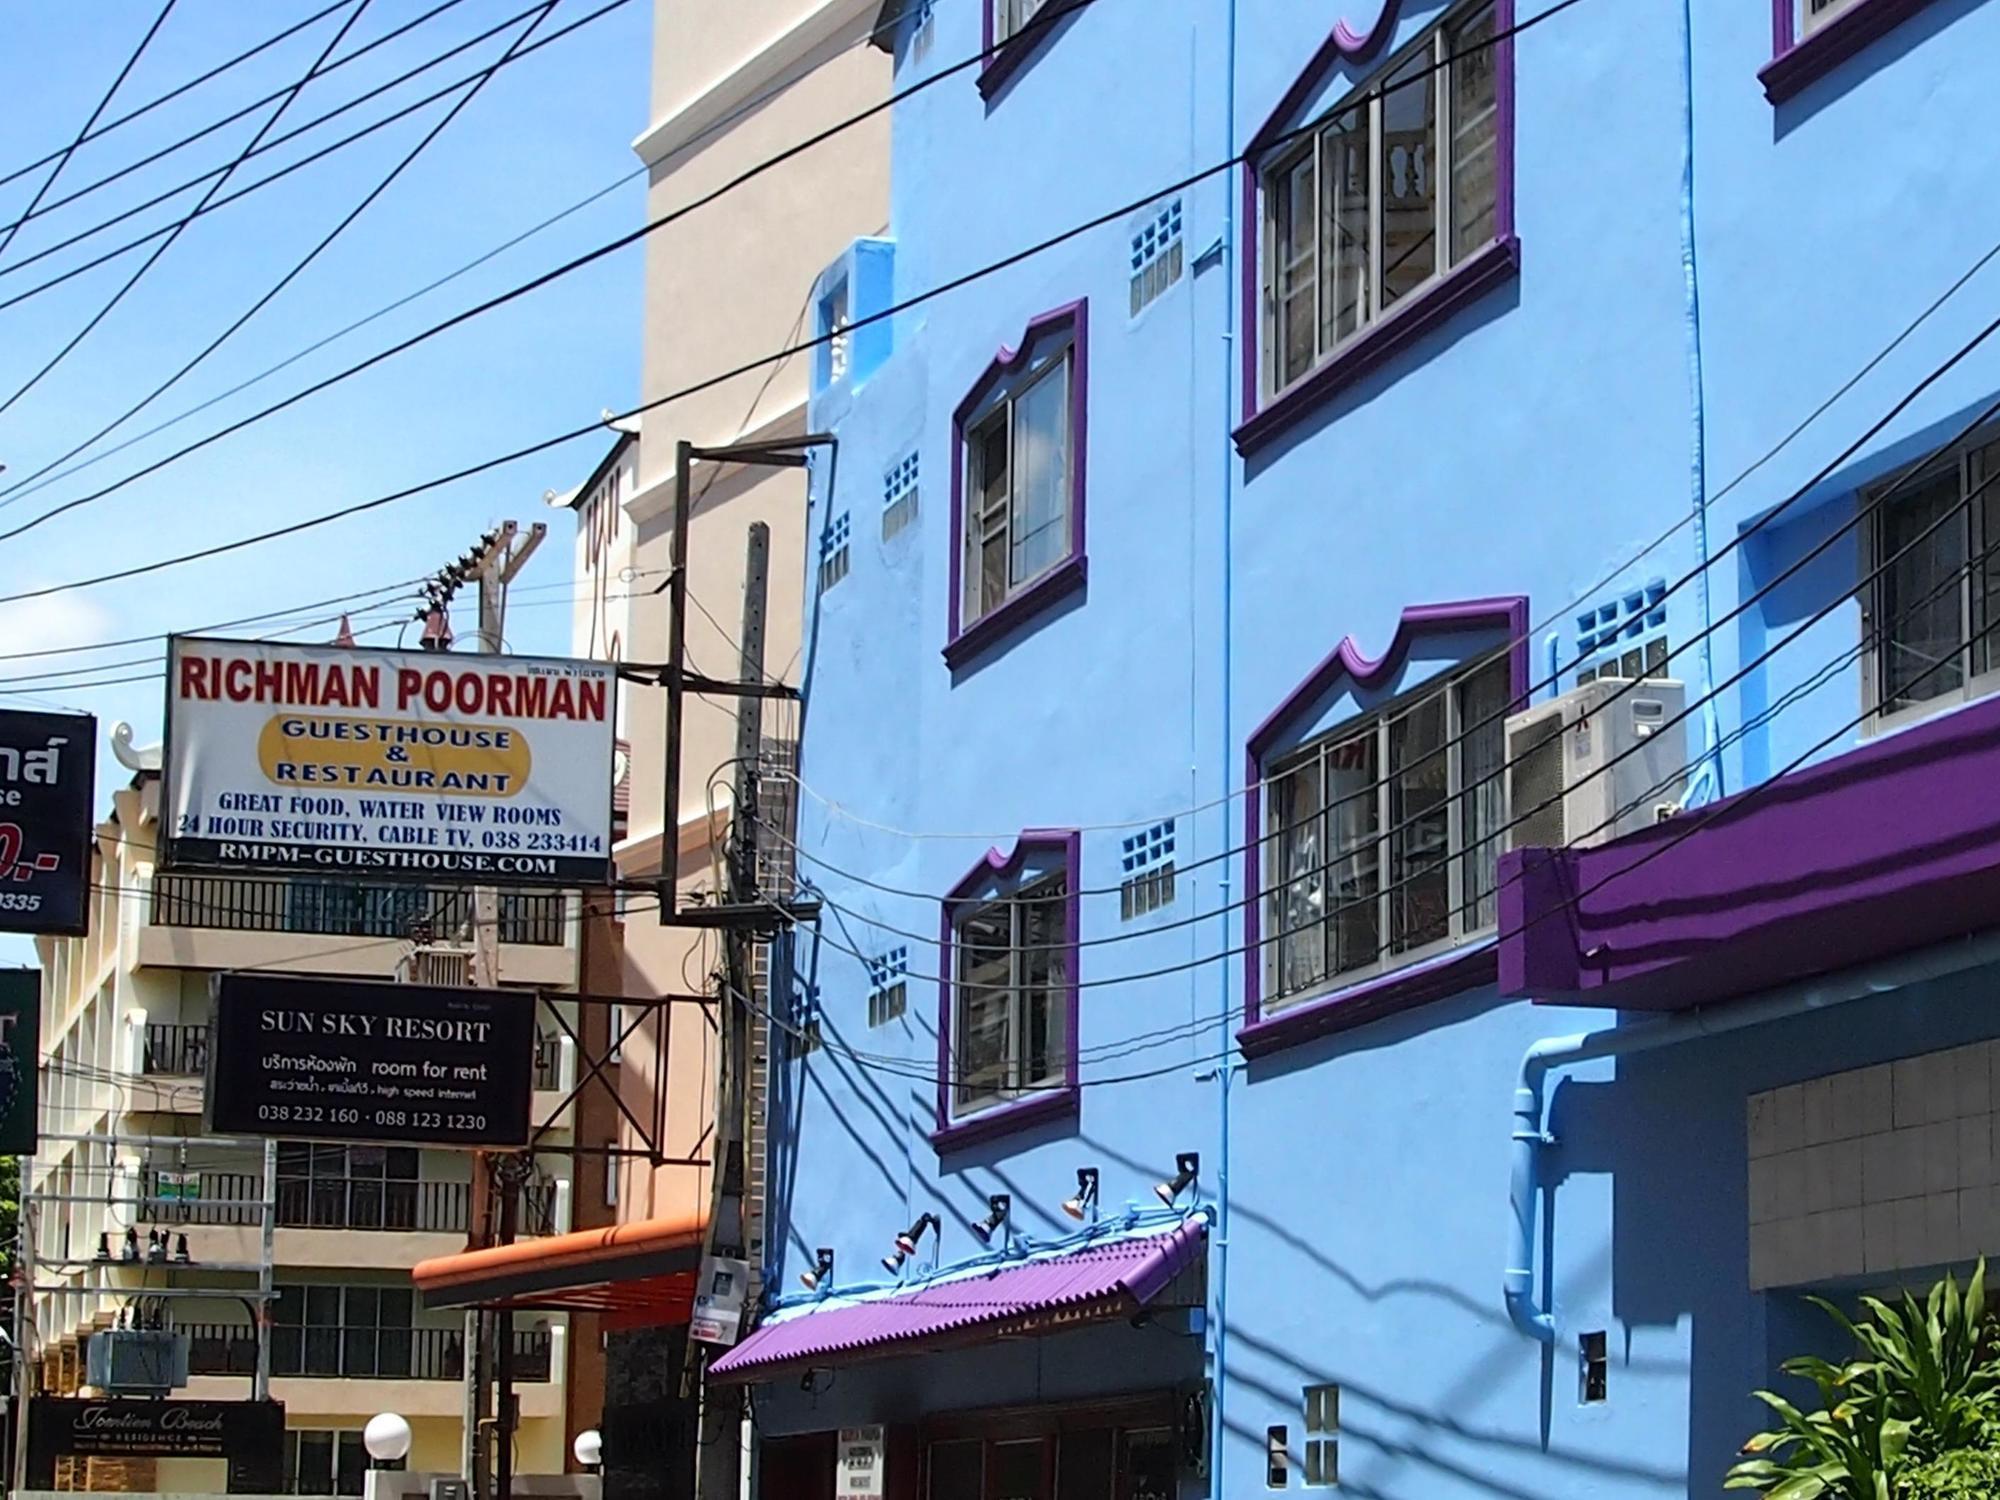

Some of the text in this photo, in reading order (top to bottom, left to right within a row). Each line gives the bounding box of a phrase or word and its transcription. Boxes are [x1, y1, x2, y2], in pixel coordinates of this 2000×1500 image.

[180, 656, 606, 722] RICHMAN POORMAN
[282, 719, 511, 750] GUESTHOUSE
[386, 745, 410, 762] &
[276, 762, 511, 792] RESTAURANT
[218, 791, 562, 826] GREAT FOOD, WATER VIEW ROOMS
[178, 813, 601, 853] 24 HOUR SECURITY, CABLE TV, 038 233414
[219, 842, 557, 875] RMPM-GUESTHOUSE.COM
[261, 1010, 491, 1043] SUN SKY RESORT
[262, 1053, 488, 1081] บริการห้องพัก room for rent
[403, 1088, 434, 1098] speed
[438, 1089, 476, 1100] internet
[258, 1104, 487, 1130] 038 232 160 088 123 1230
